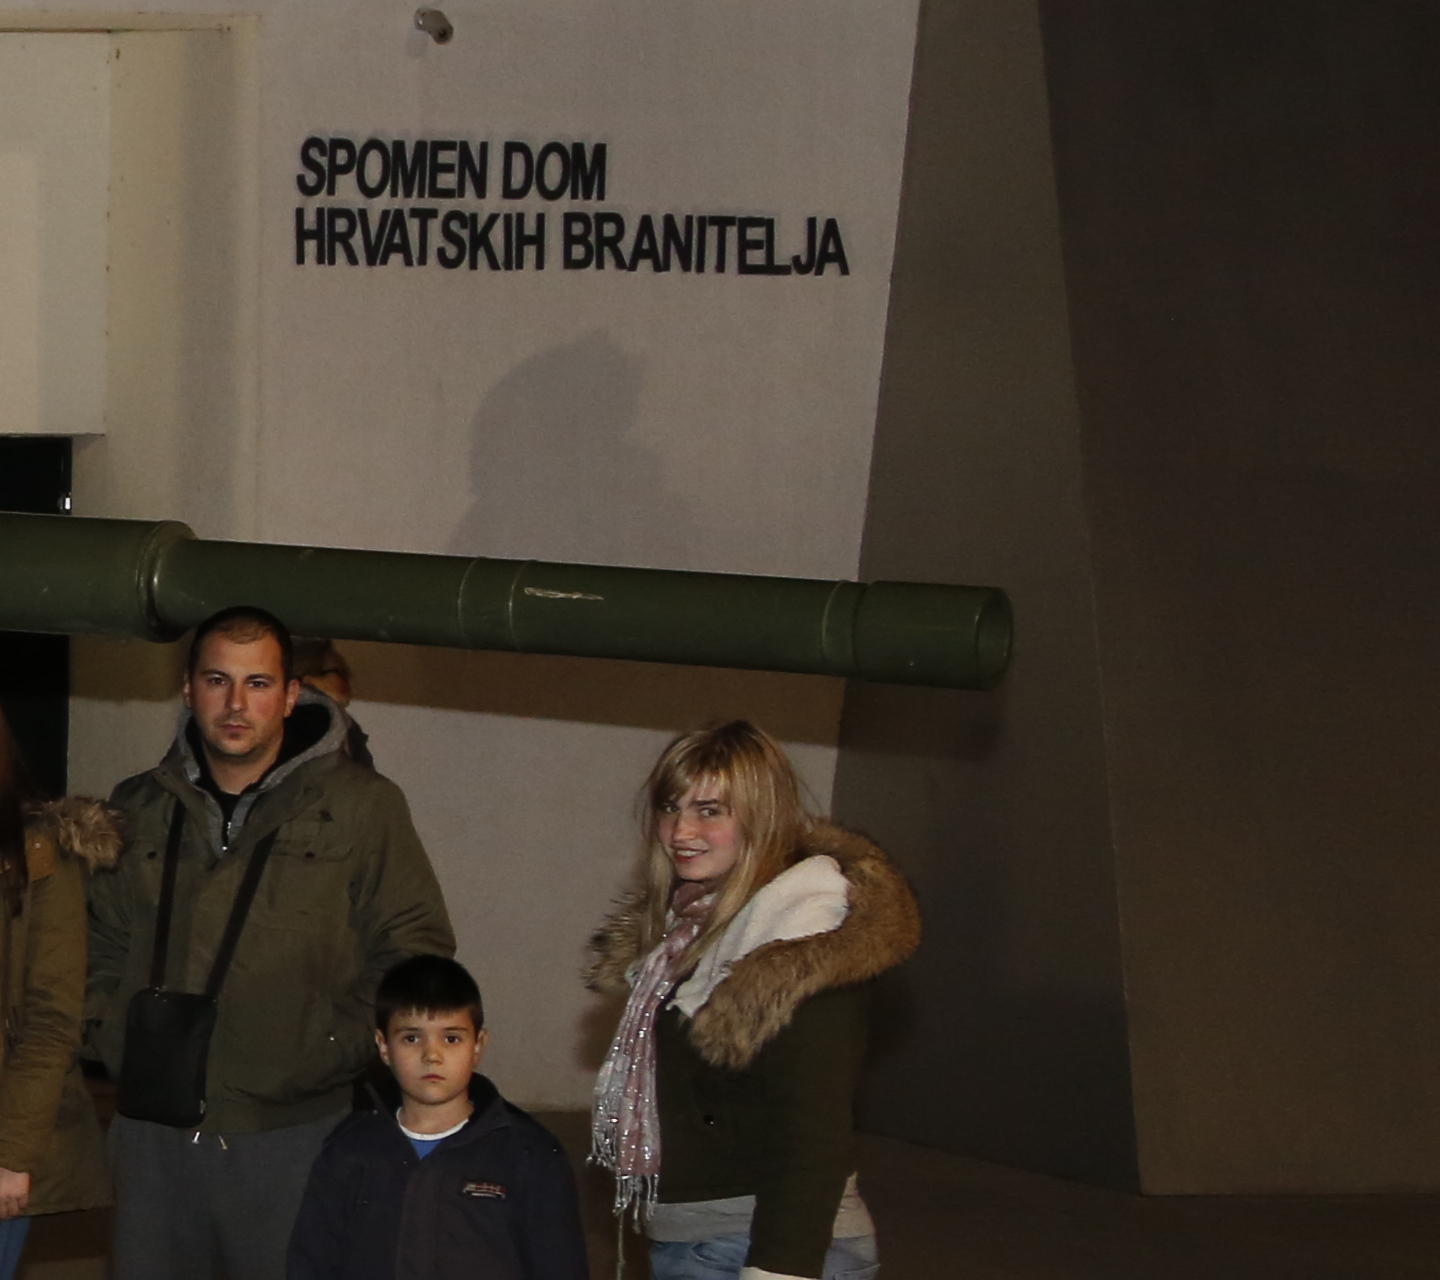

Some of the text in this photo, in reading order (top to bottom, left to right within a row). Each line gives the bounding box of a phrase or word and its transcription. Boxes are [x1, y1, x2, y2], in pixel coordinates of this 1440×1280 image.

[296, 137, 607, 200] SPOMEN DOM
[295, 208, 850, 276] HRVATSKIH BRANITELJA
